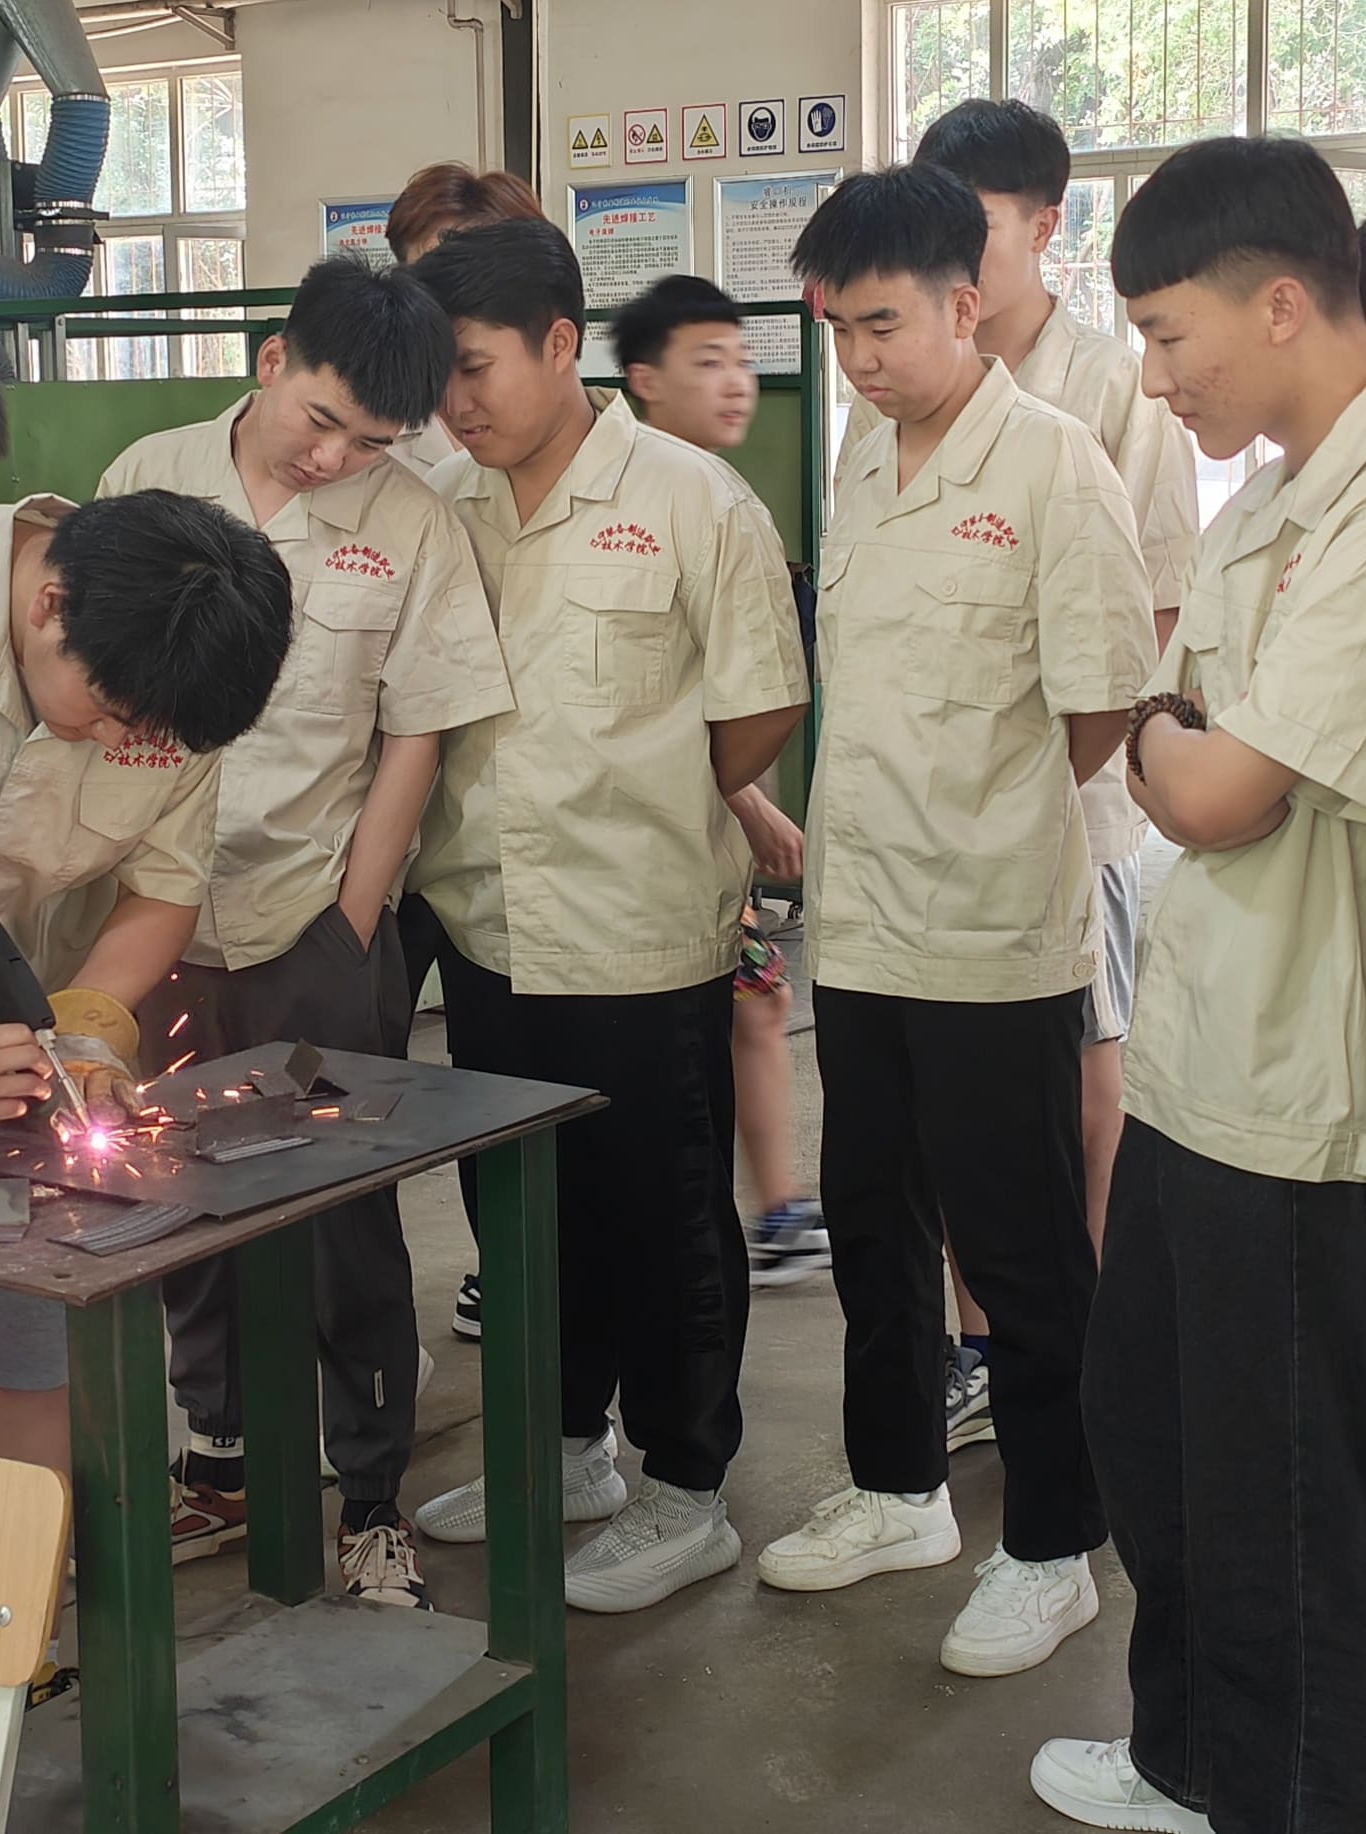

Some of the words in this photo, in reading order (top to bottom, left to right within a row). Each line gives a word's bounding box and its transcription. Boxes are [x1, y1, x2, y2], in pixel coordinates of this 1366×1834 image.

[602, 539, 648, 555] 技术学院
[335, 559, 382, 578] 技术学院
[117, 753, 170, 768] 技术学院
